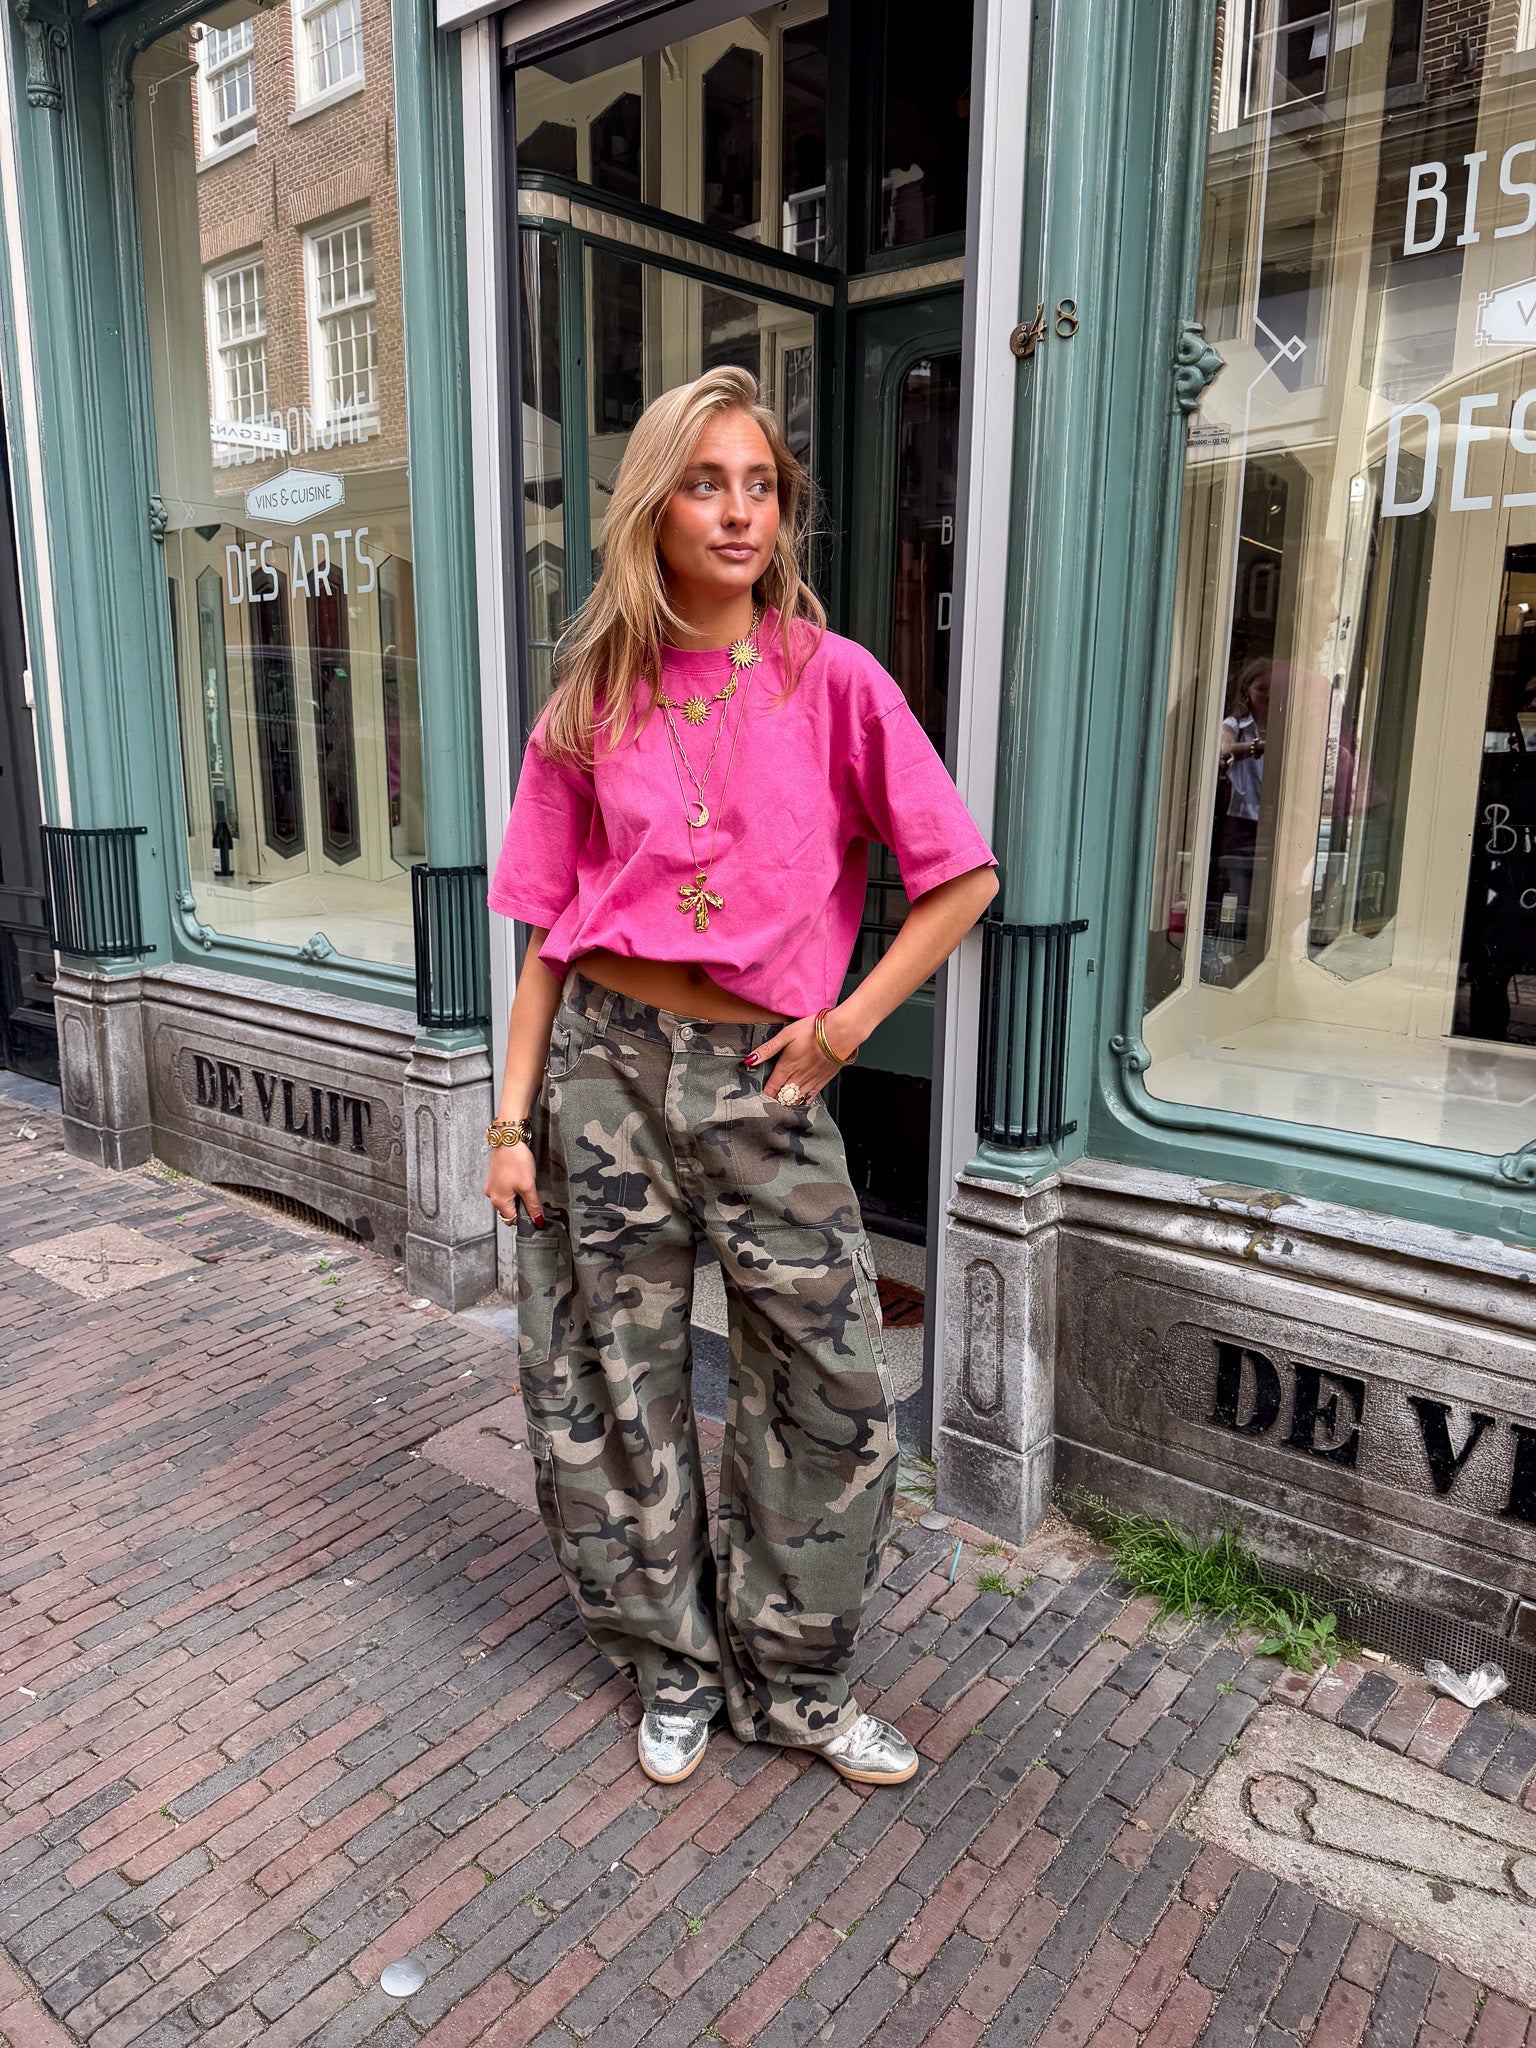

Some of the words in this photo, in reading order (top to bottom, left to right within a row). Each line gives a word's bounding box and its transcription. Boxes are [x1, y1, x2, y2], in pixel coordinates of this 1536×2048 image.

[1403, 139, 1536, 256] BIS
[255, 493, 279, 510] VINS
[280, 487, 290, 506] &
[290, 483, 332, 506] CUISINE
[1381, 389, 1536, 518] DES
[225, 538, 280, 605] DES
[291, 526, 376, 599] ARTS
[941, 515, 954, 546] B
[192, 1054, 244, 1118] DE
[250, 1069, 372, 1154] VLIJT
[1206, 1338, 1368, 1469] DE
